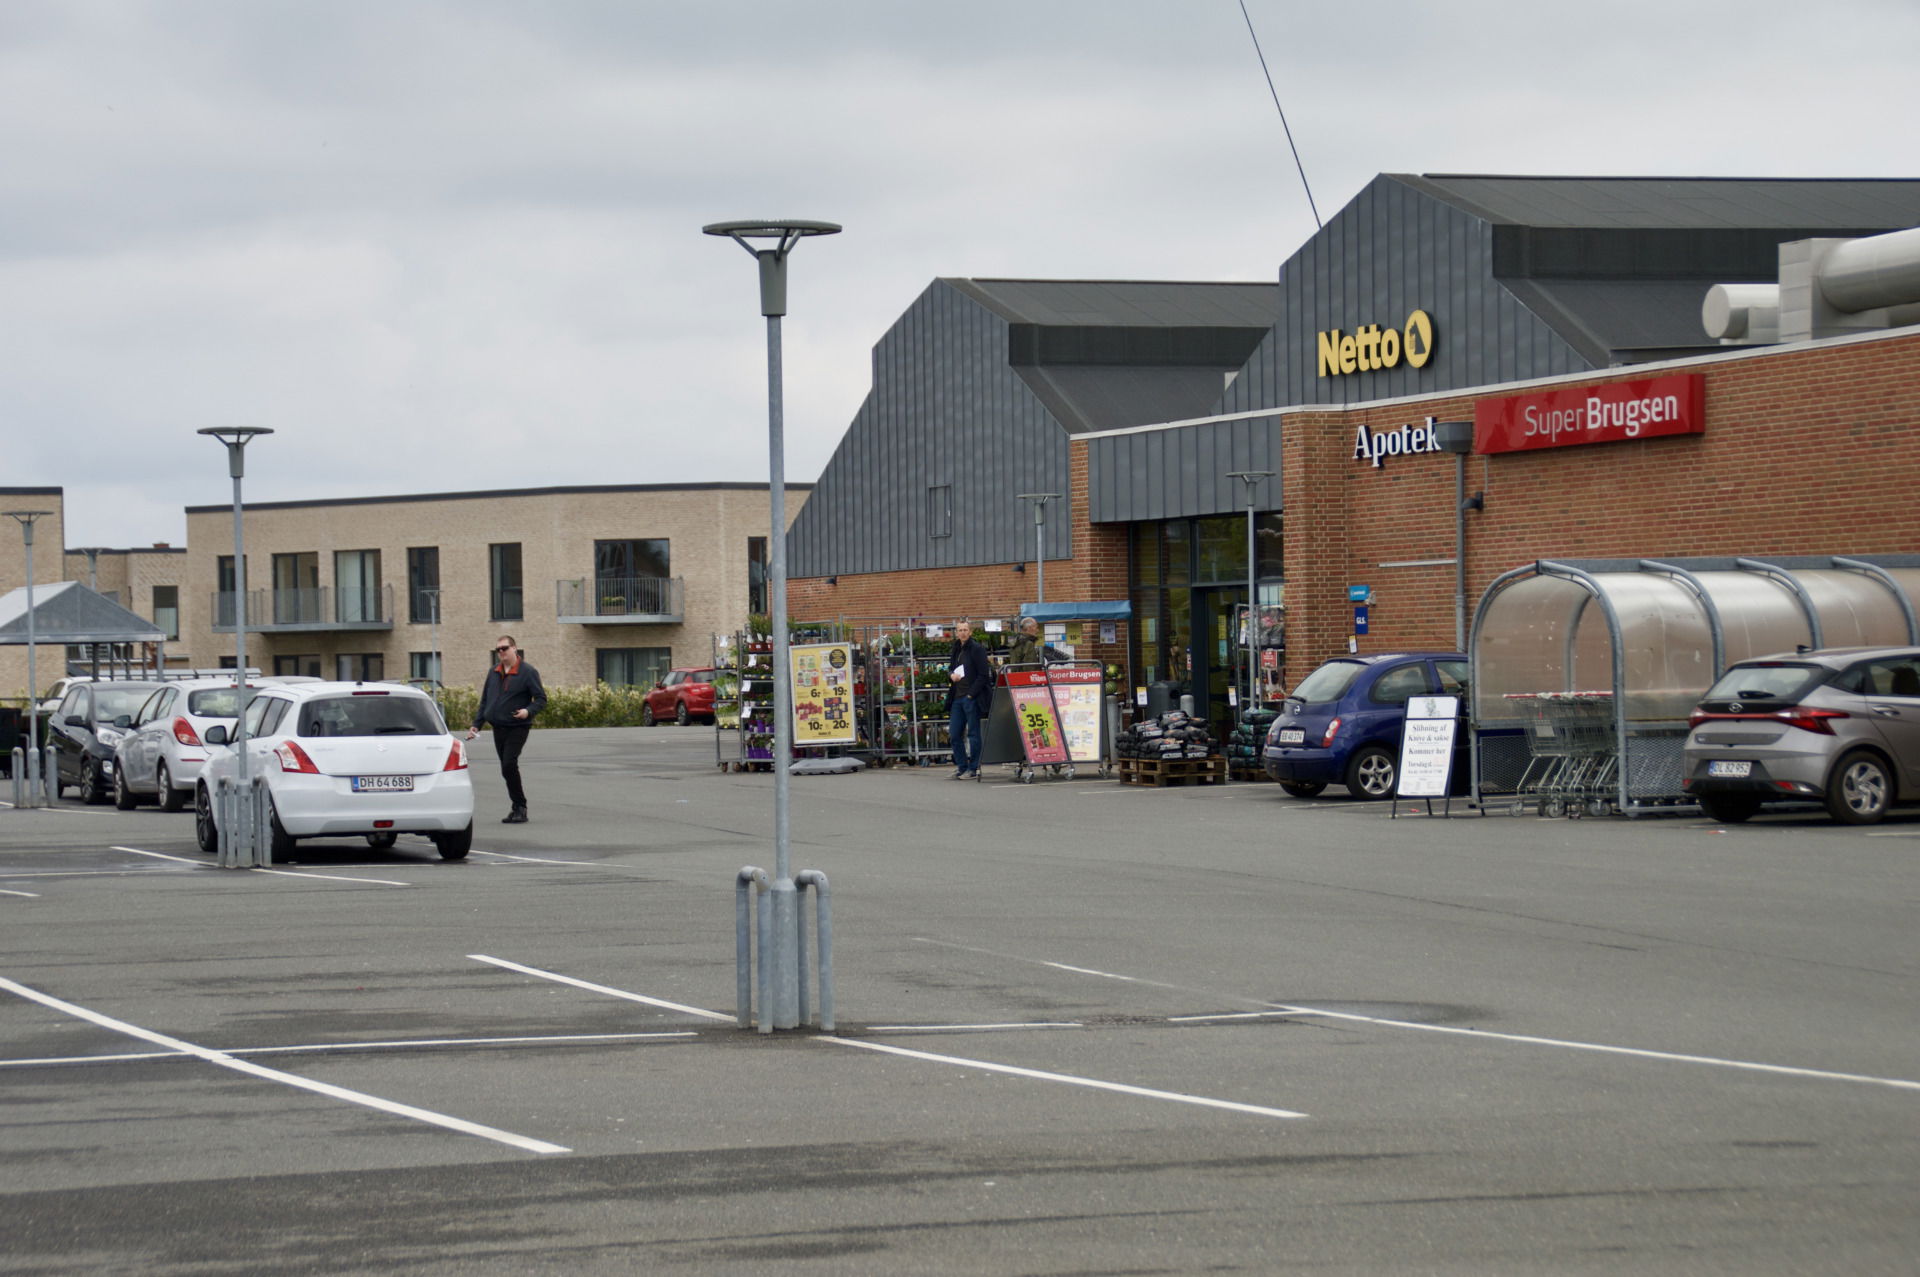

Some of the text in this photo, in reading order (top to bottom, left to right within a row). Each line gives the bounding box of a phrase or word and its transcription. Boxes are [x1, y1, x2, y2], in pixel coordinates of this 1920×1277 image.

[1319, 324, 1400, 377] Netto
[1352, 416, 1441, 467] Apotek
[360, 776, 411, 787] DH 64 688
